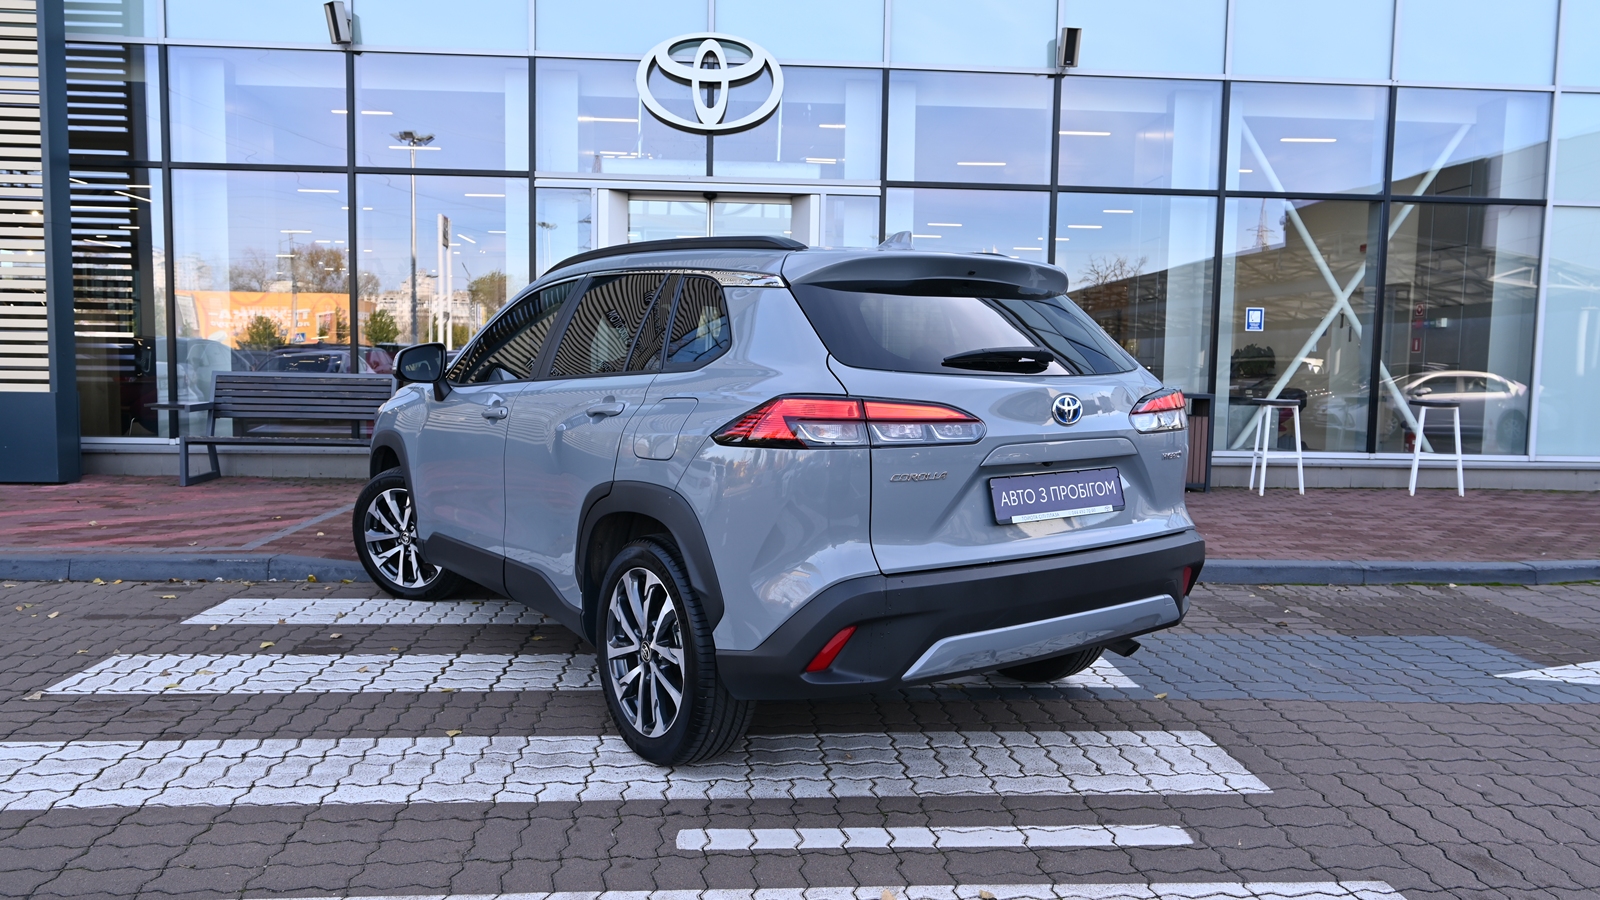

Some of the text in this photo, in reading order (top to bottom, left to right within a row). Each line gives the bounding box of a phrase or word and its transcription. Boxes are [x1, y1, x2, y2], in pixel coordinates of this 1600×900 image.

[889, 471, 948, 482] COROLLA
[1001, 480, 1117, 507] АВТО З ПРОБІГОМ
